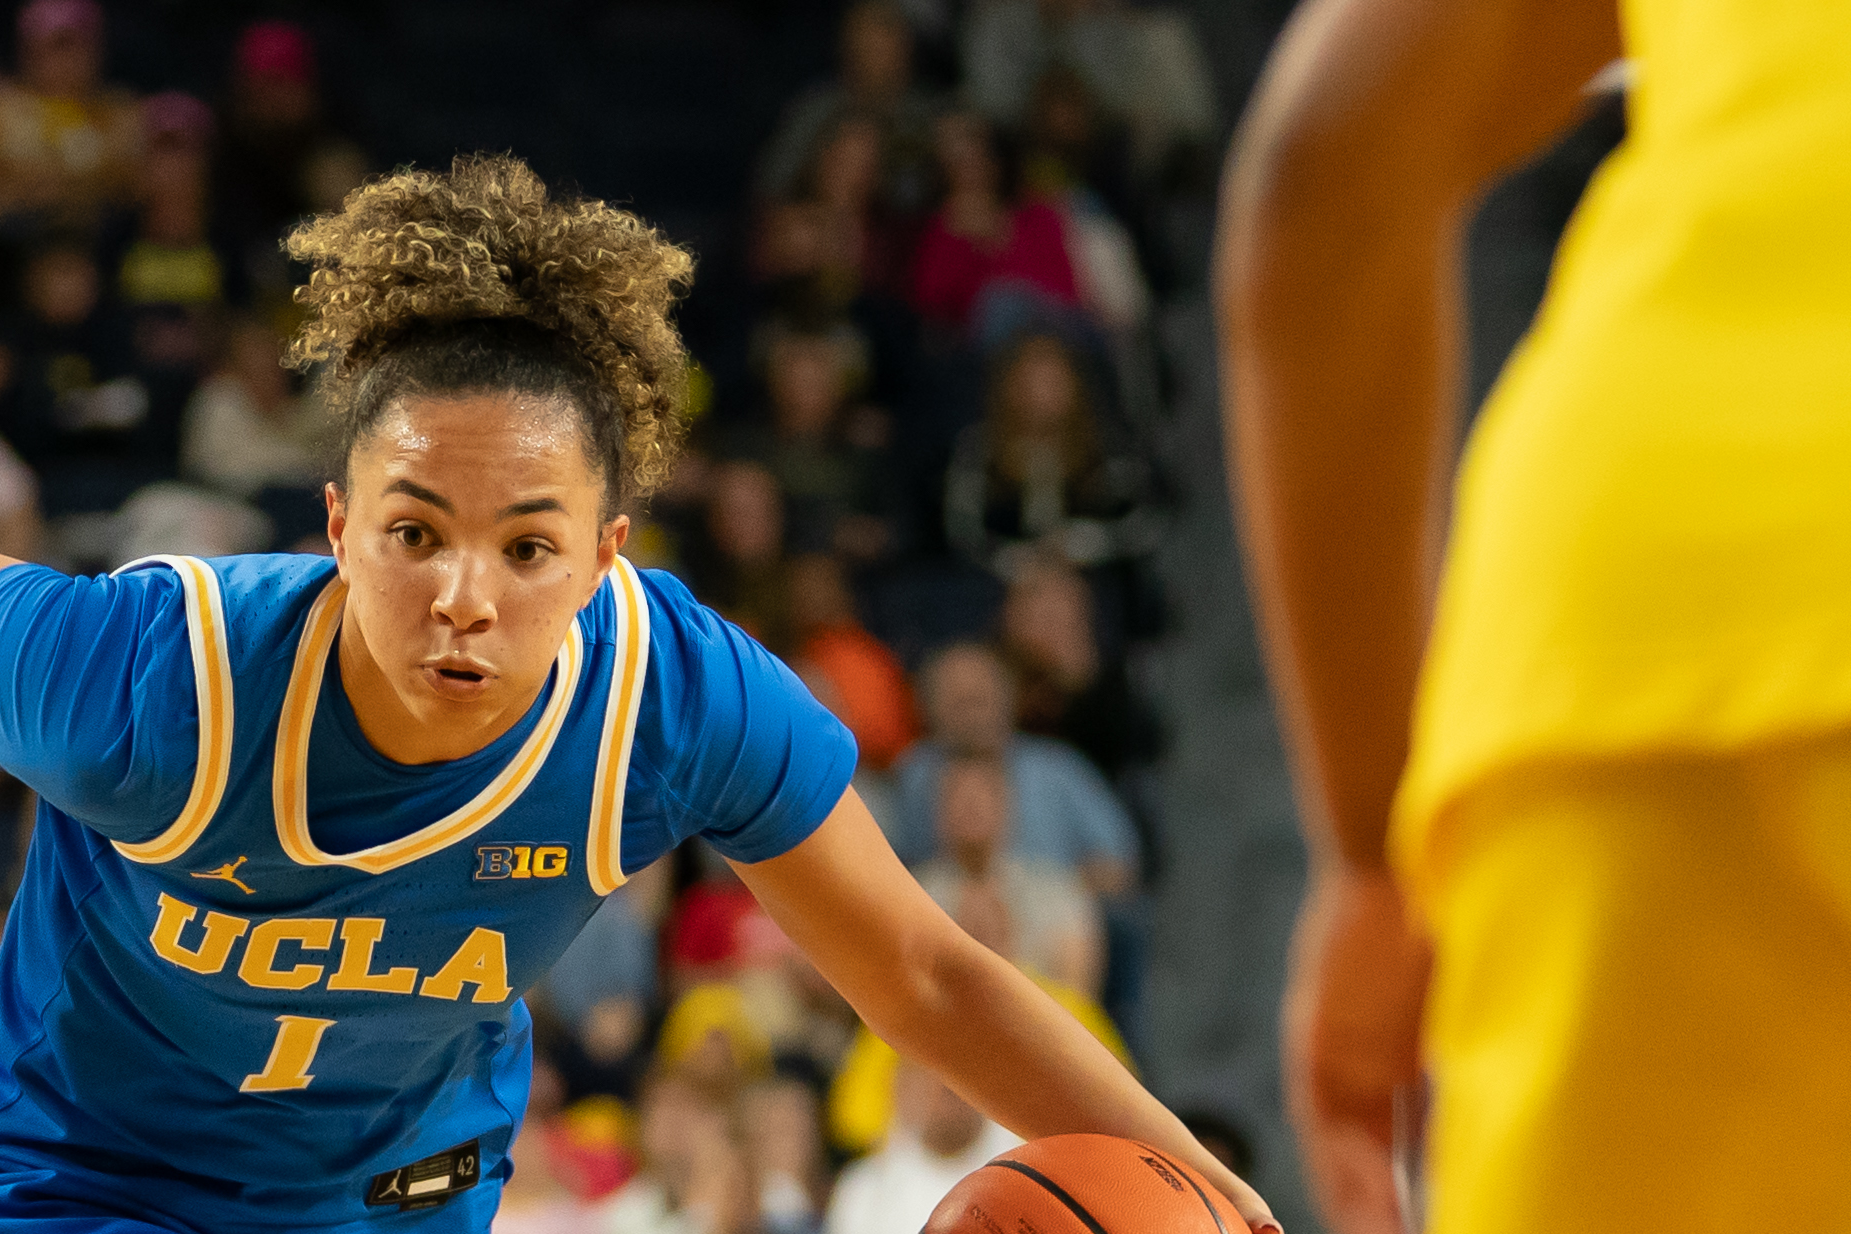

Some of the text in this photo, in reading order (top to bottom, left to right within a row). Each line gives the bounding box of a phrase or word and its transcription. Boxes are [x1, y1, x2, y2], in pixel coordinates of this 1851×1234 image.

[150, 892, 512, 1004] UCLA
[239, 1014, 337, 1093] 1
[457, 1155, 475, 1177] 42
